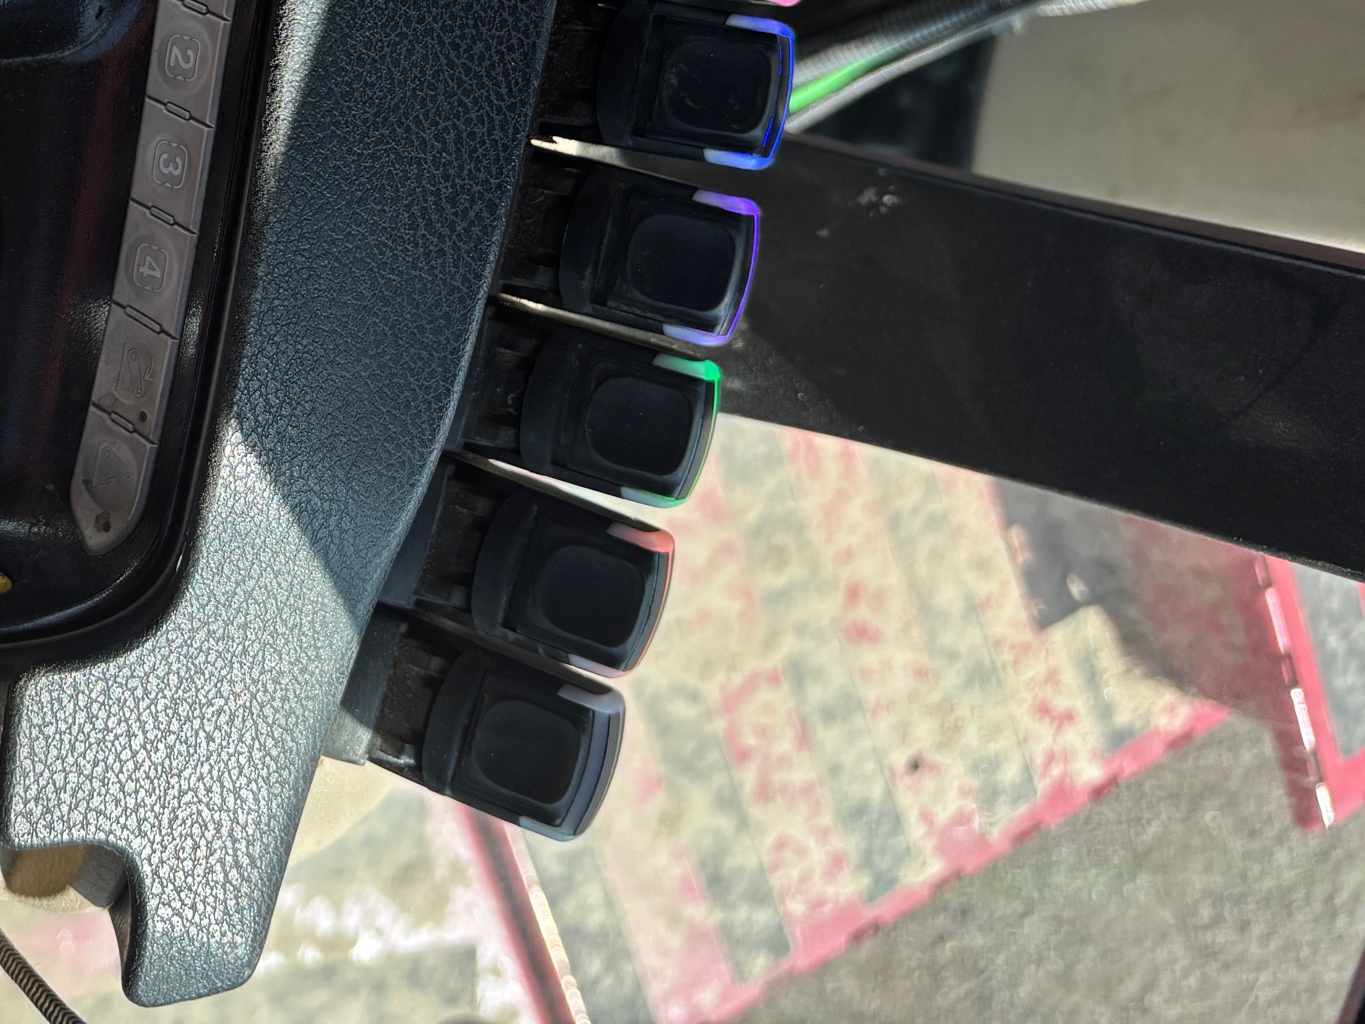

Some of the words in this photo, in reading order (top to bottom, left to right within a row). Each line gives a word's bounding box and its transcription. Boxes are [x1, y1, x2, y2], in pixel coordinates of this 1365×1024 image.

[169, 45, 194, 69] 2
[158, 153, 182, 176] 3
[138, 255, 161, 279] 4
